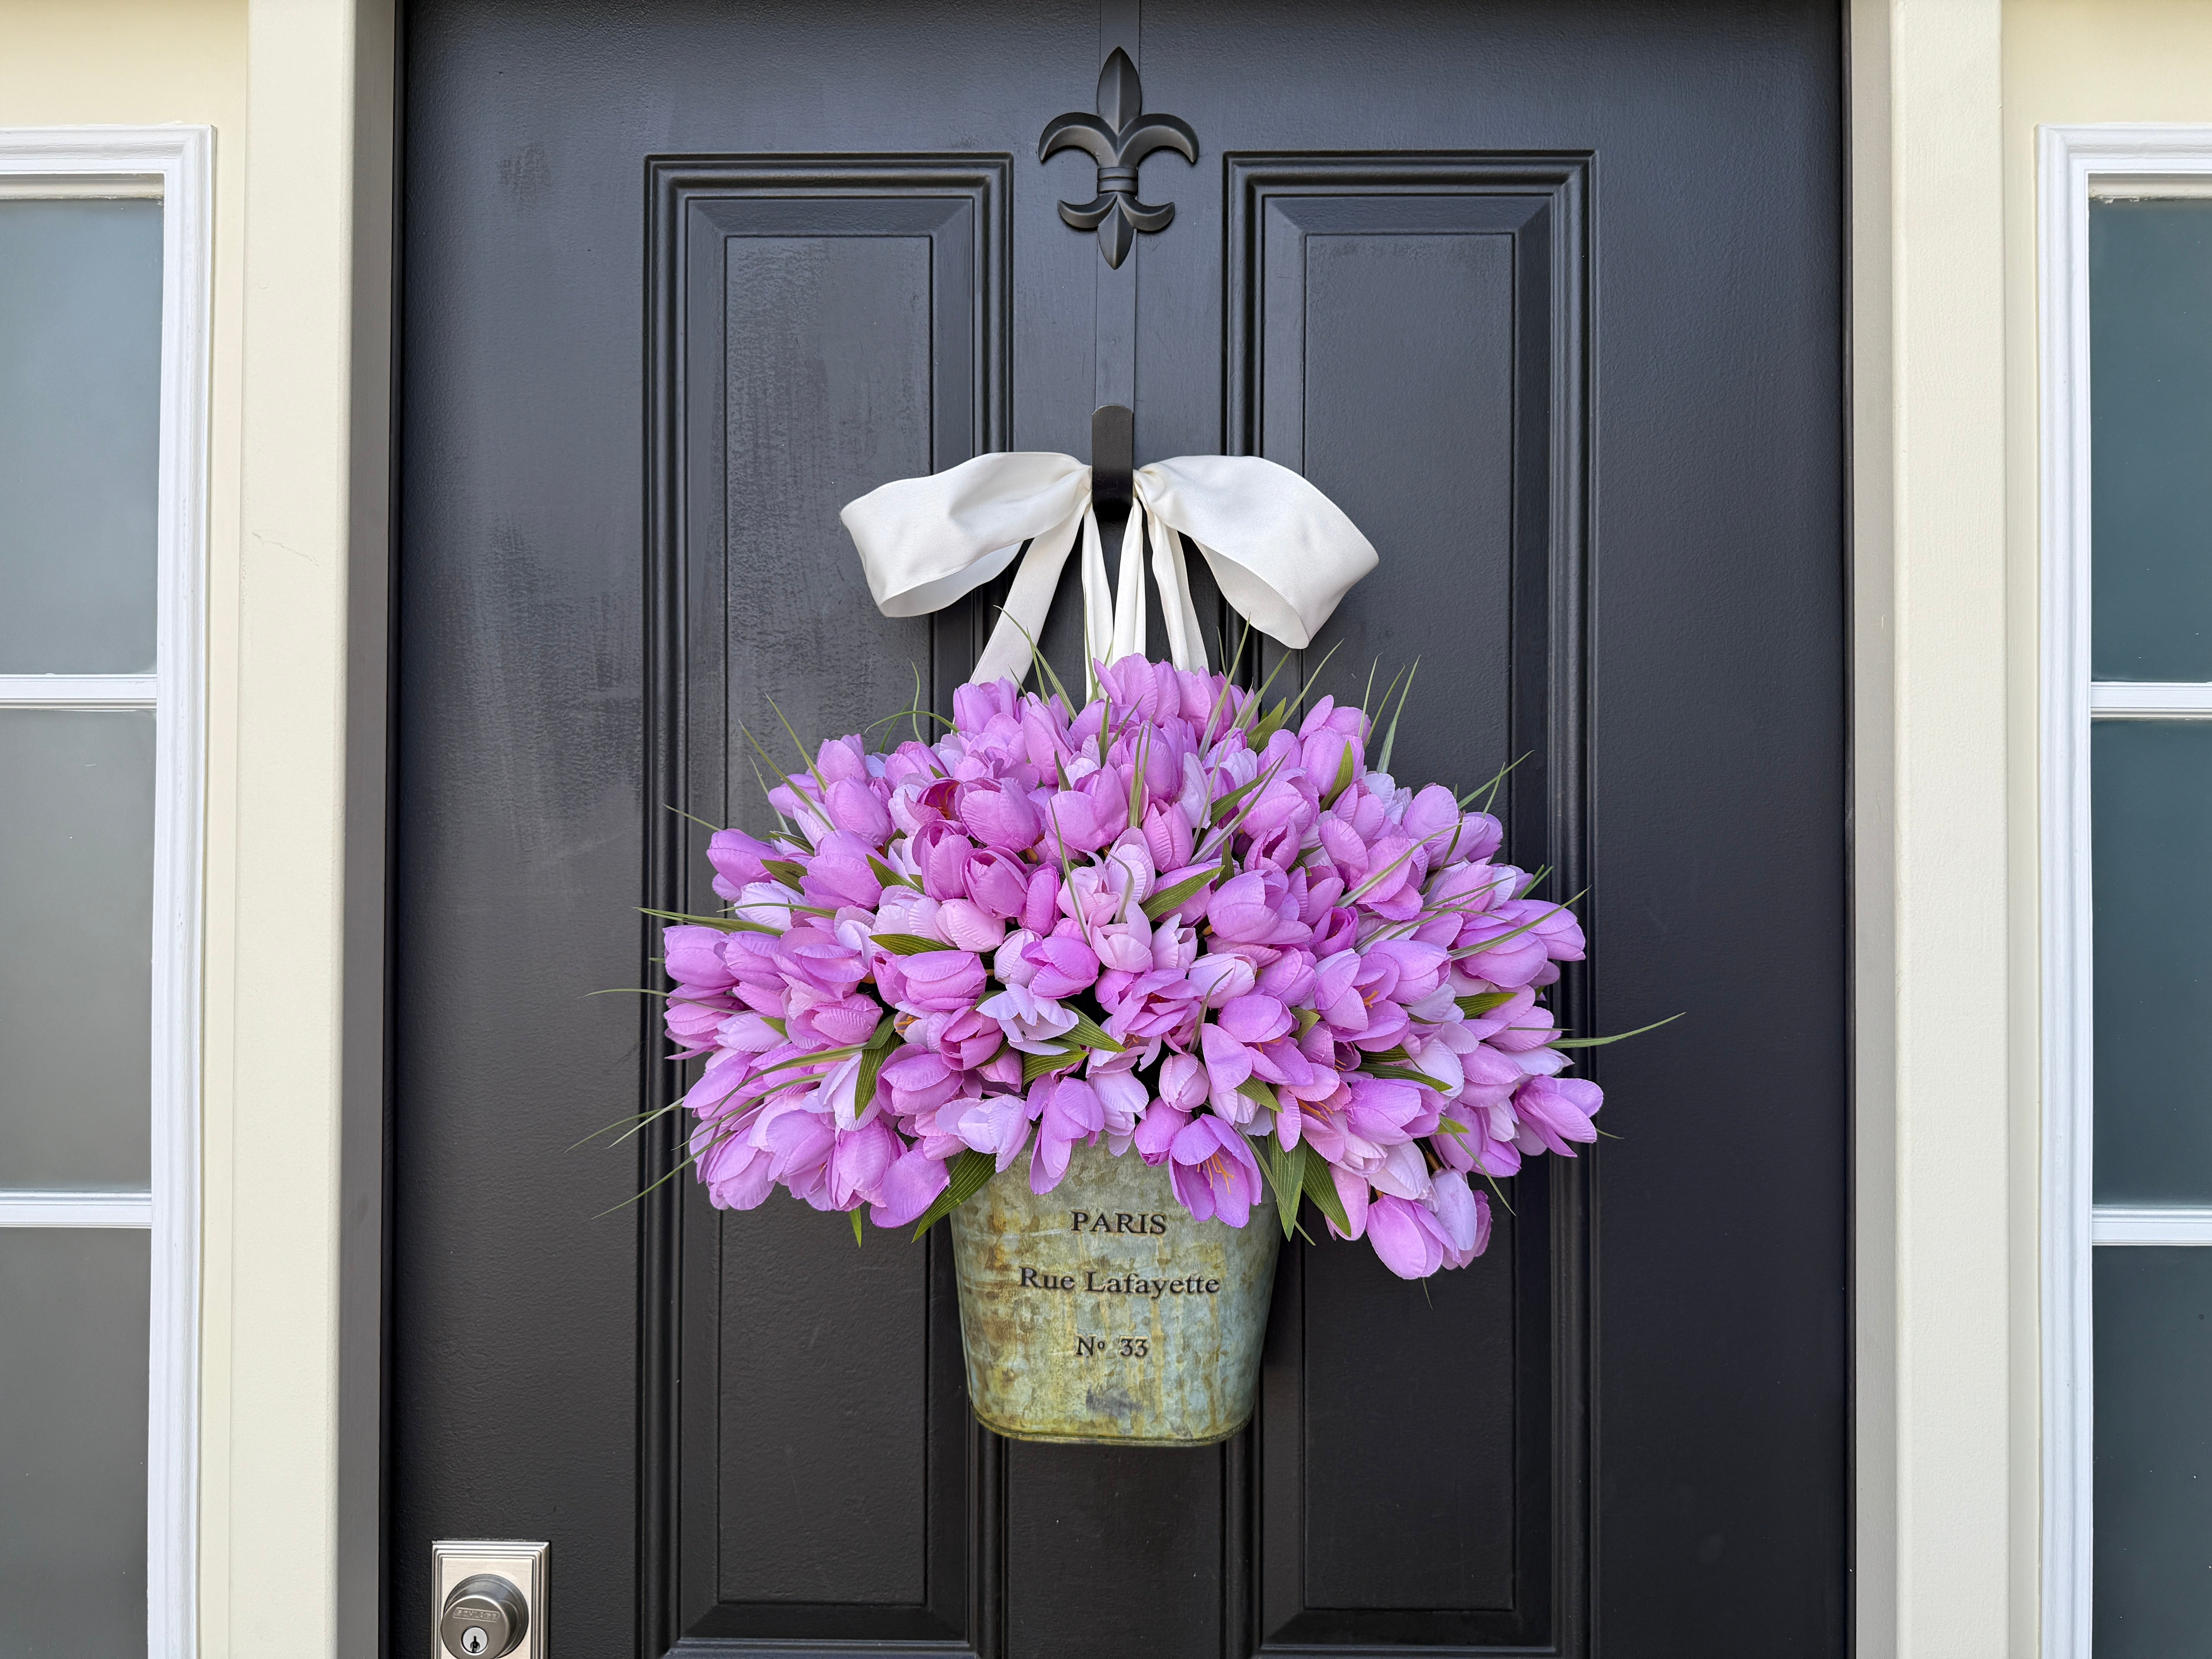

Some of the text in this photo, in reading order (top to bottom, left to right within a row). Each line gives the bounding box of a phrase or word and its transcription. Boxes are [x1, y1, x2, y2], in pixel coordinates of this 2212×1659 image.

[1070, 1211, 1167, 1235] PARIS
[1019, 1266, 1220, 1299] Rue Lafayette
[1120, 1336, 1149, 1357] 33
